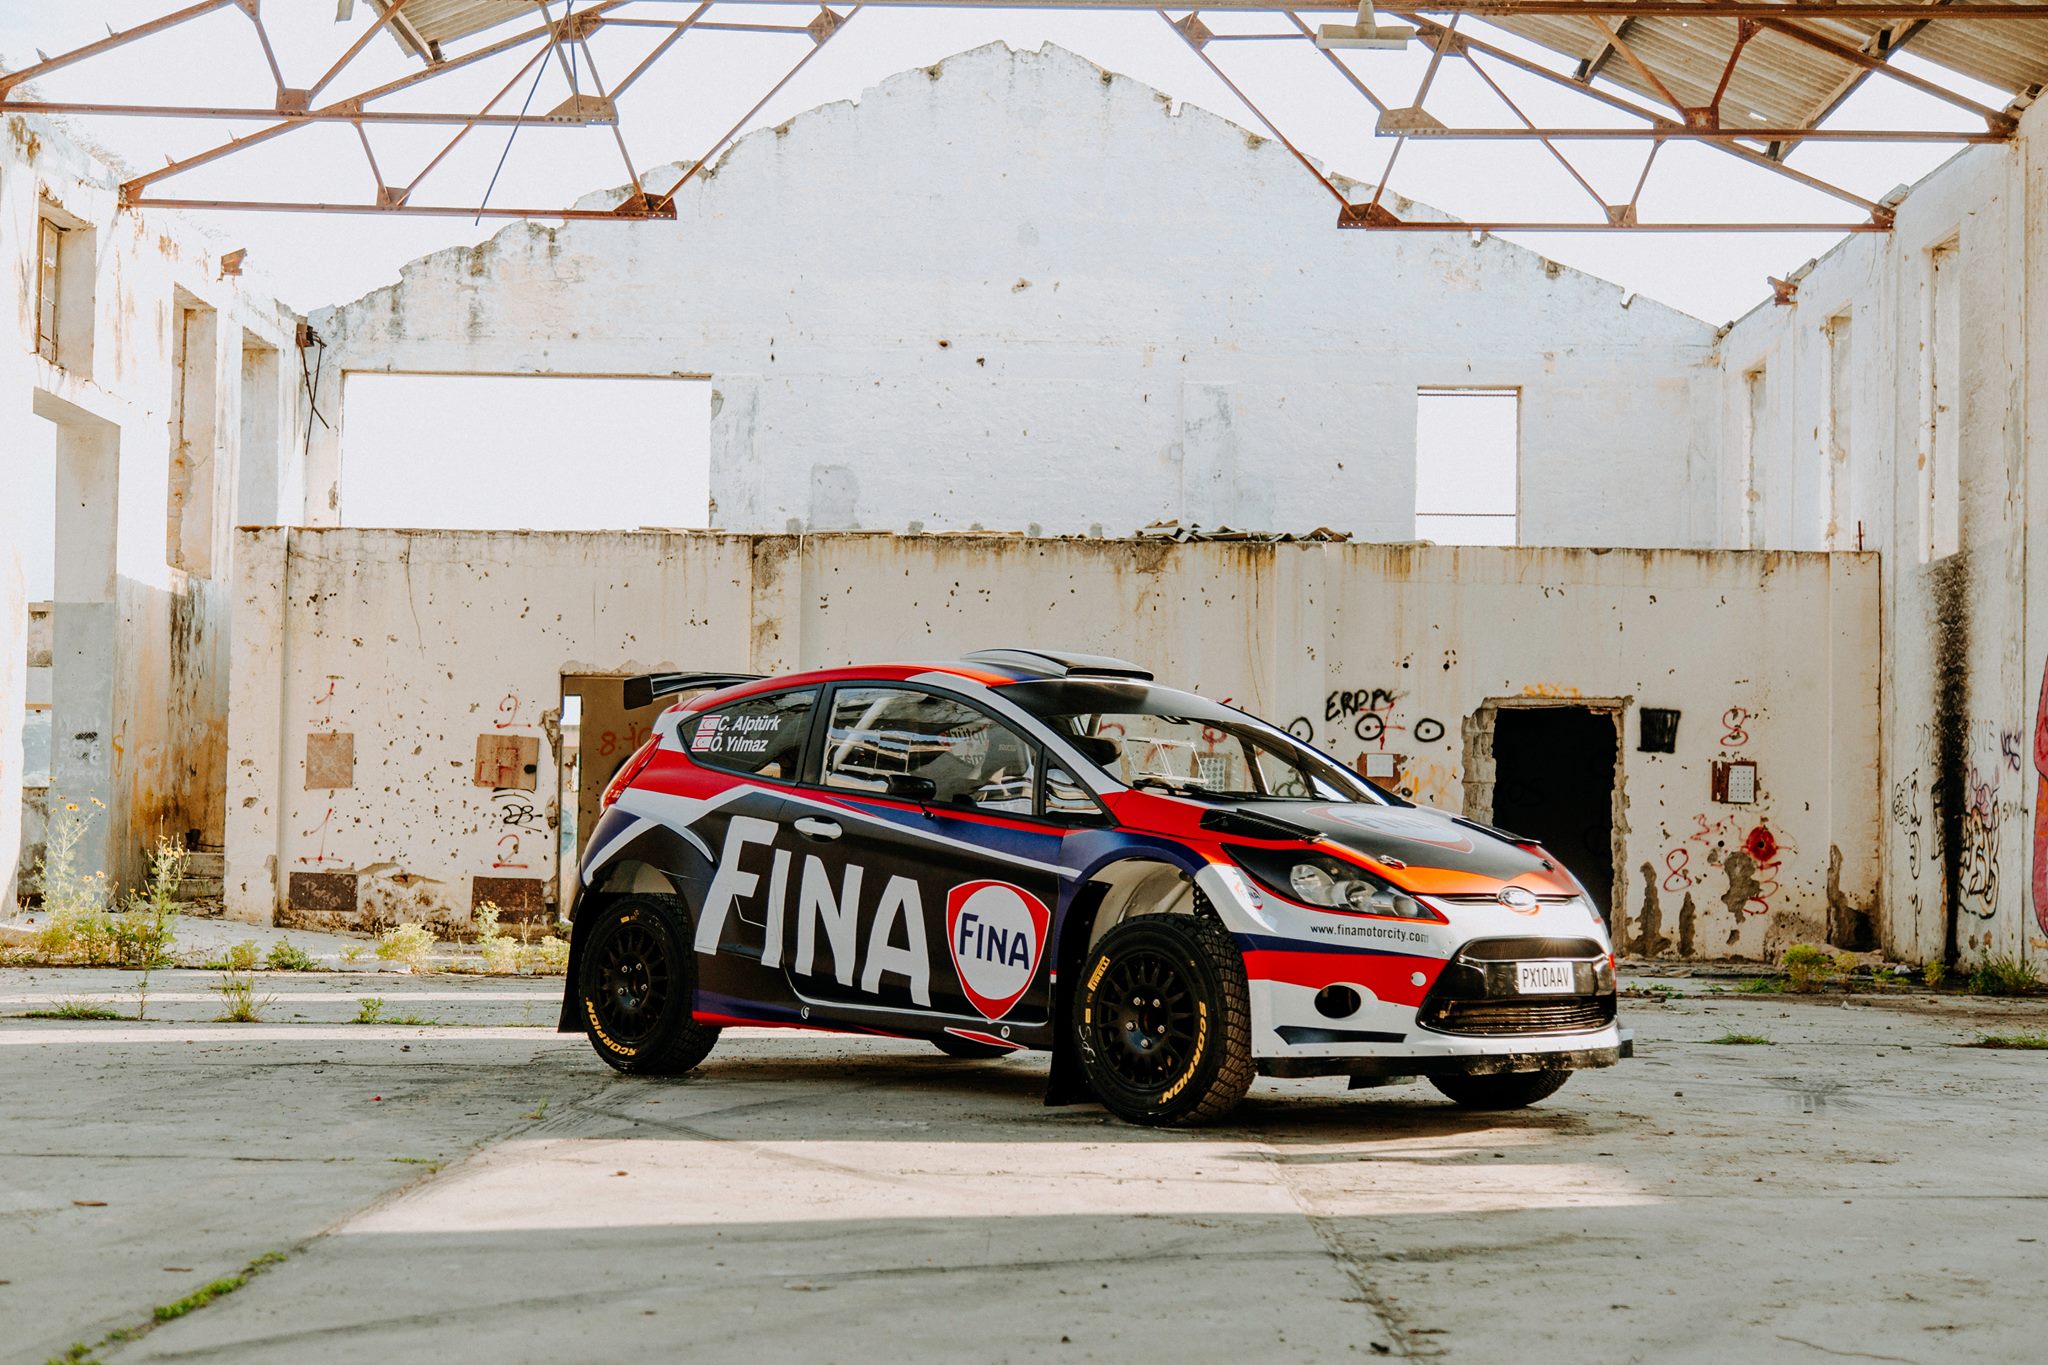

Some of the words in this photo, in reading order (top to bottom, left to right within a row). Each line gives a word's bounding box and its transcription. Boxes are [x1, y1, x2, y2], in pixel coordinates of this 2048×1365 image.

[717, 715, 730, 732] C.
[731, 715, 781, 735] Alptürk
[710, 732, 723, 752] Ö.
[726, 735, 768, 753] Yılmaz
[694, 814, 932, 1008] FINA
[958, 911, 1030, 971] FINA
[1310, 923, 1429, 944] www.finamotorcity.com
[1522, 967, 1569, 989] PX10AAV
